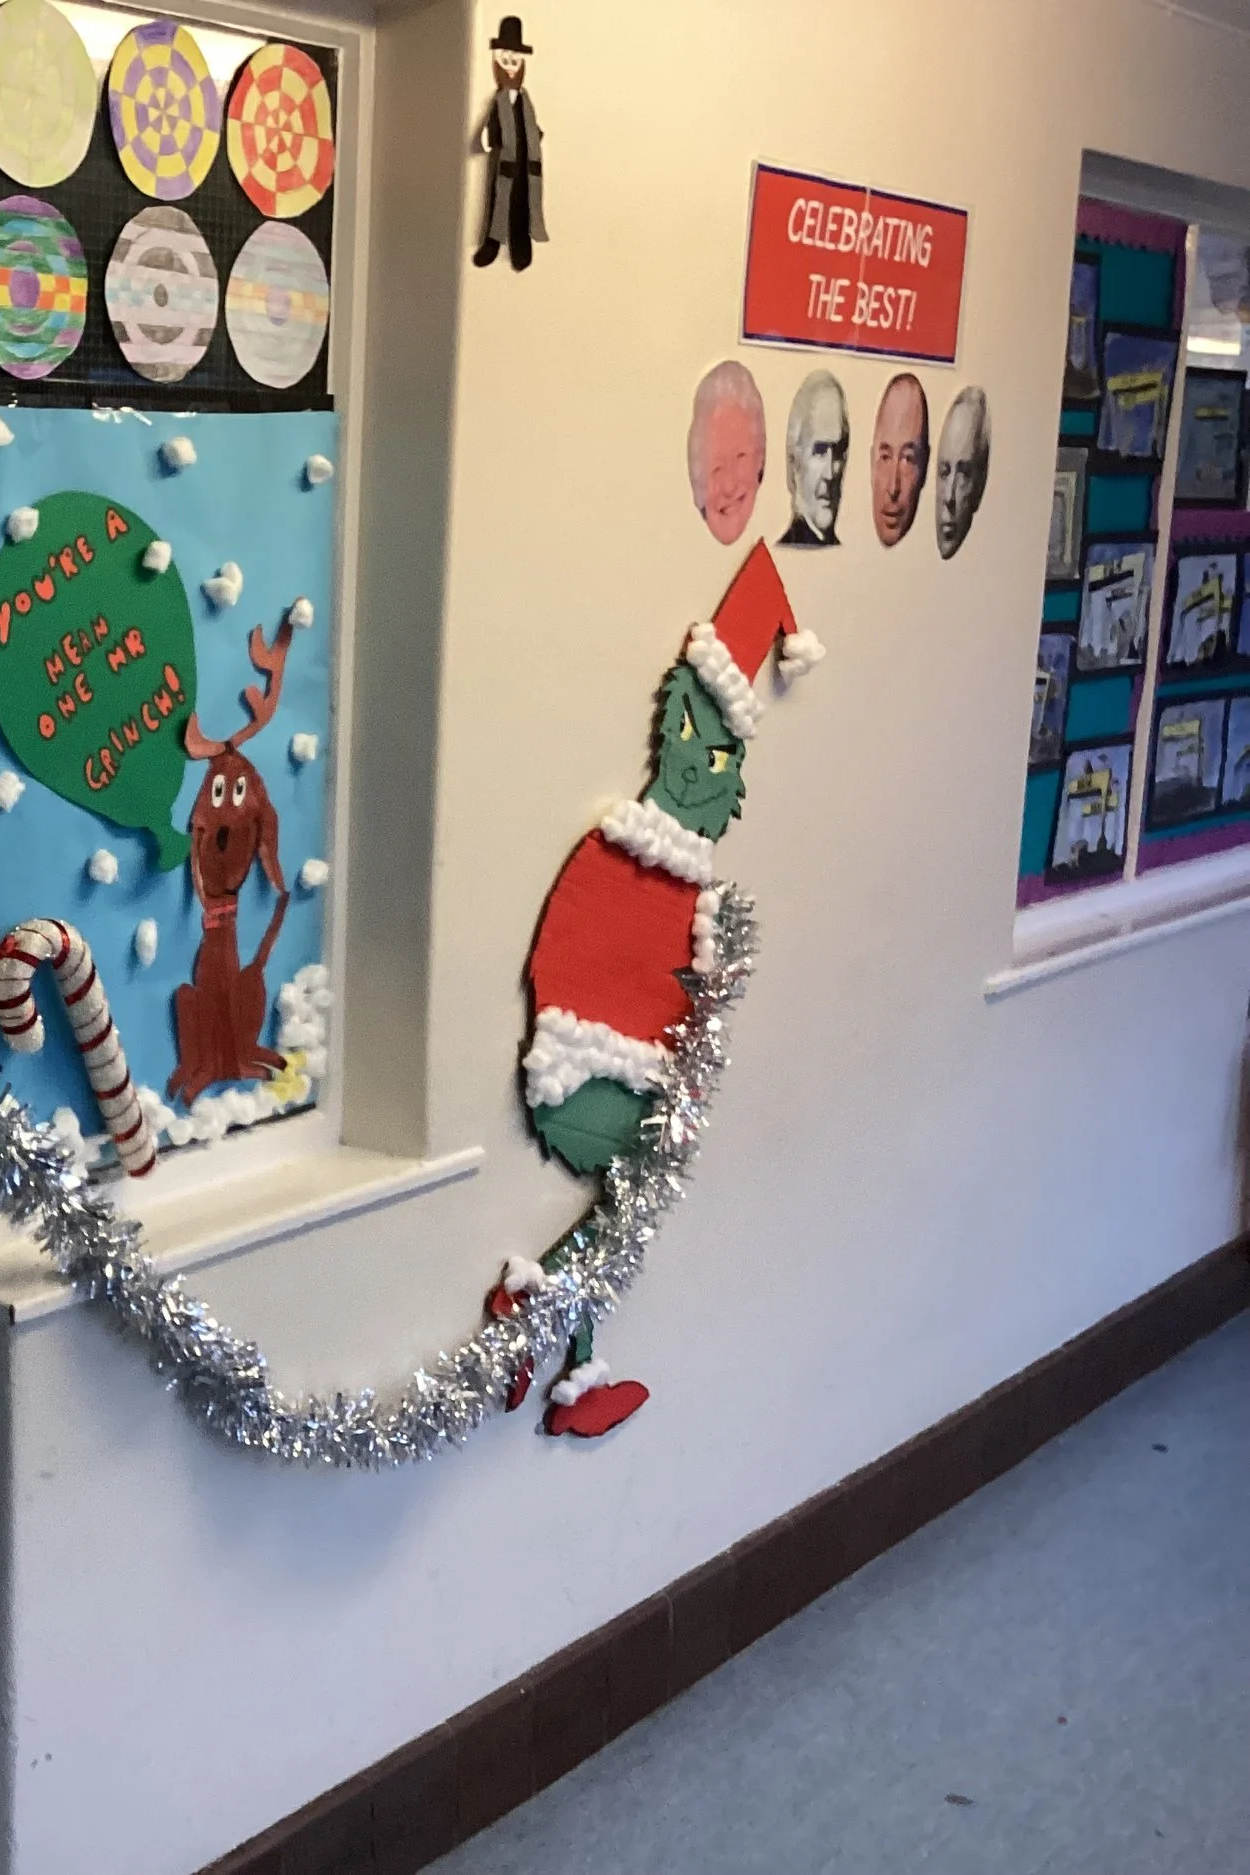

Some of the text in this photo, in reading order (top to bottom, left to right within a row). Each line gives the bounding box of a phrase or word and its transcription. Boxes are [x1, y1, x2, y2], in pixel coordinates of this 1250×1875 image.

[787, 197, 934, 268] CELEBRATING
[807, 273, 918, 331] THE BEST!
[104, 505, 131, 544] A
[36, 624, 147, 742] ONE MR
[43, 613, 110, 686] MEAN
[82, 661, 187, 792] GRINCH!
